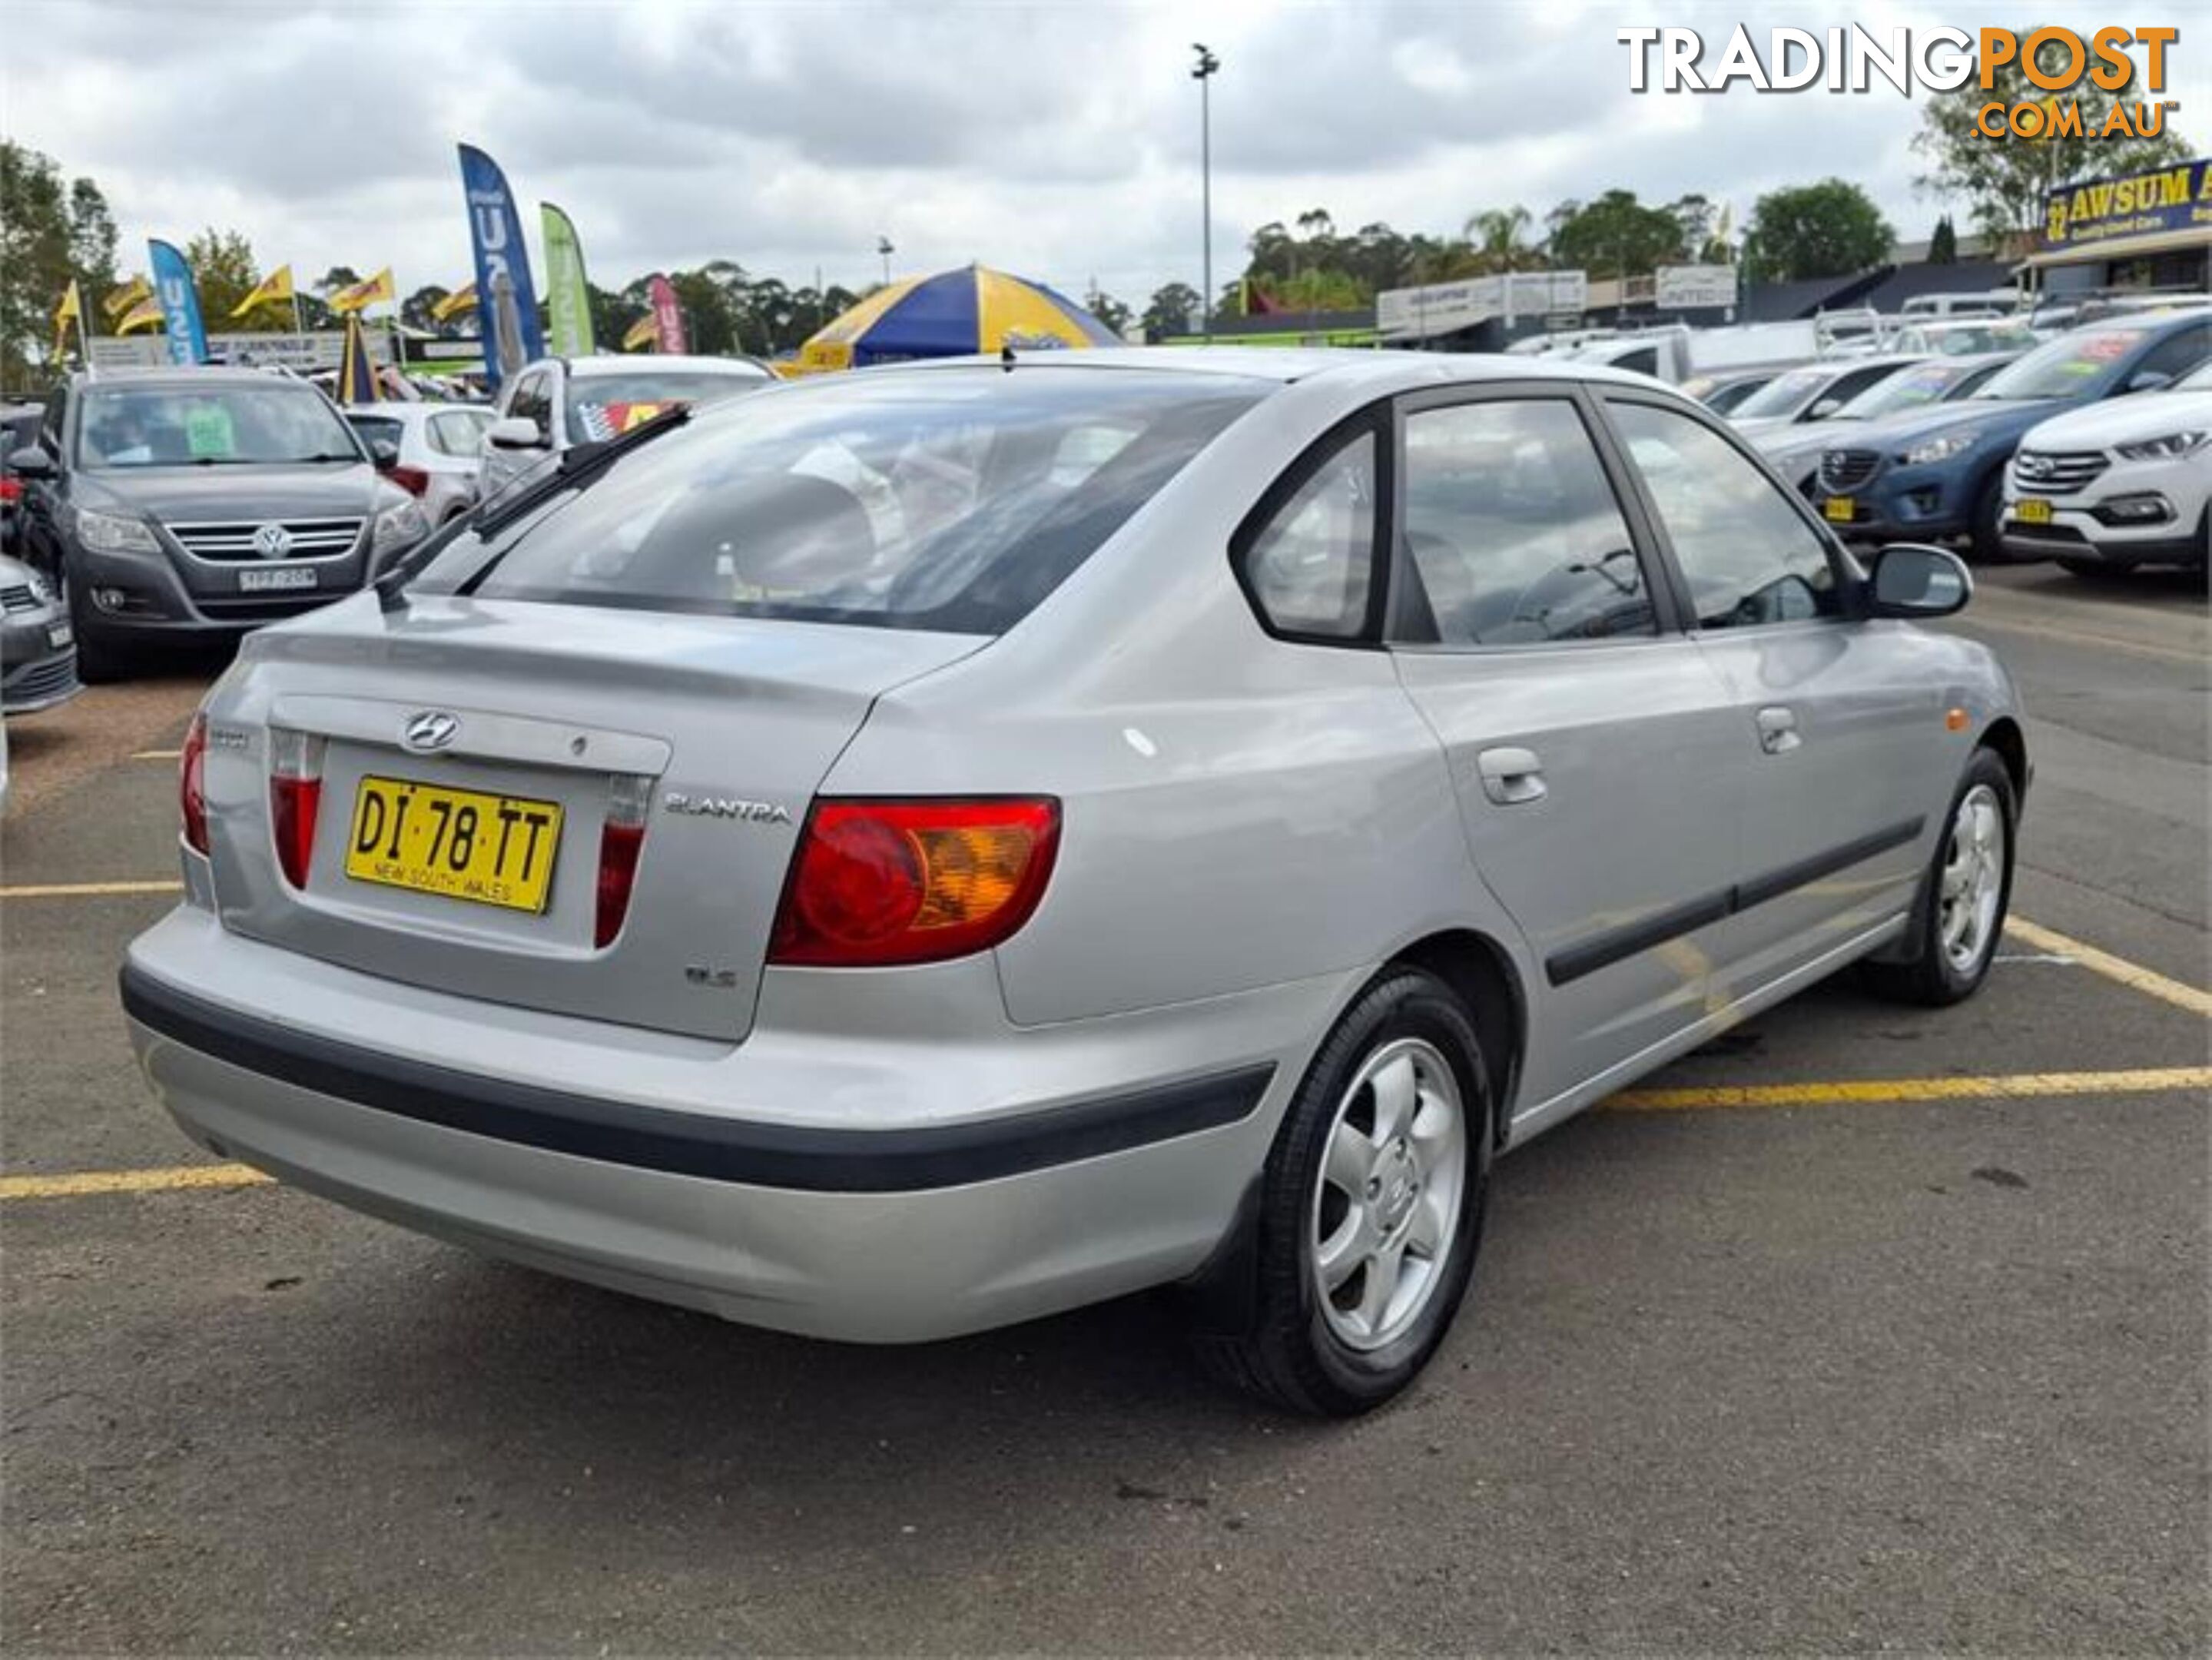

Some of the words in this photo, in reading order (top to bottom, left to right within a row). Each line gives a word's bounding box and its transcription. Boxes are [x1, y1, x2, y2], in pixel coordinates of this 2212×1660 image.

[2070, 167, 2191, 221] AWSUM
[426, 800, 478, 872] 78
[493, 808, 550, 882] TT
